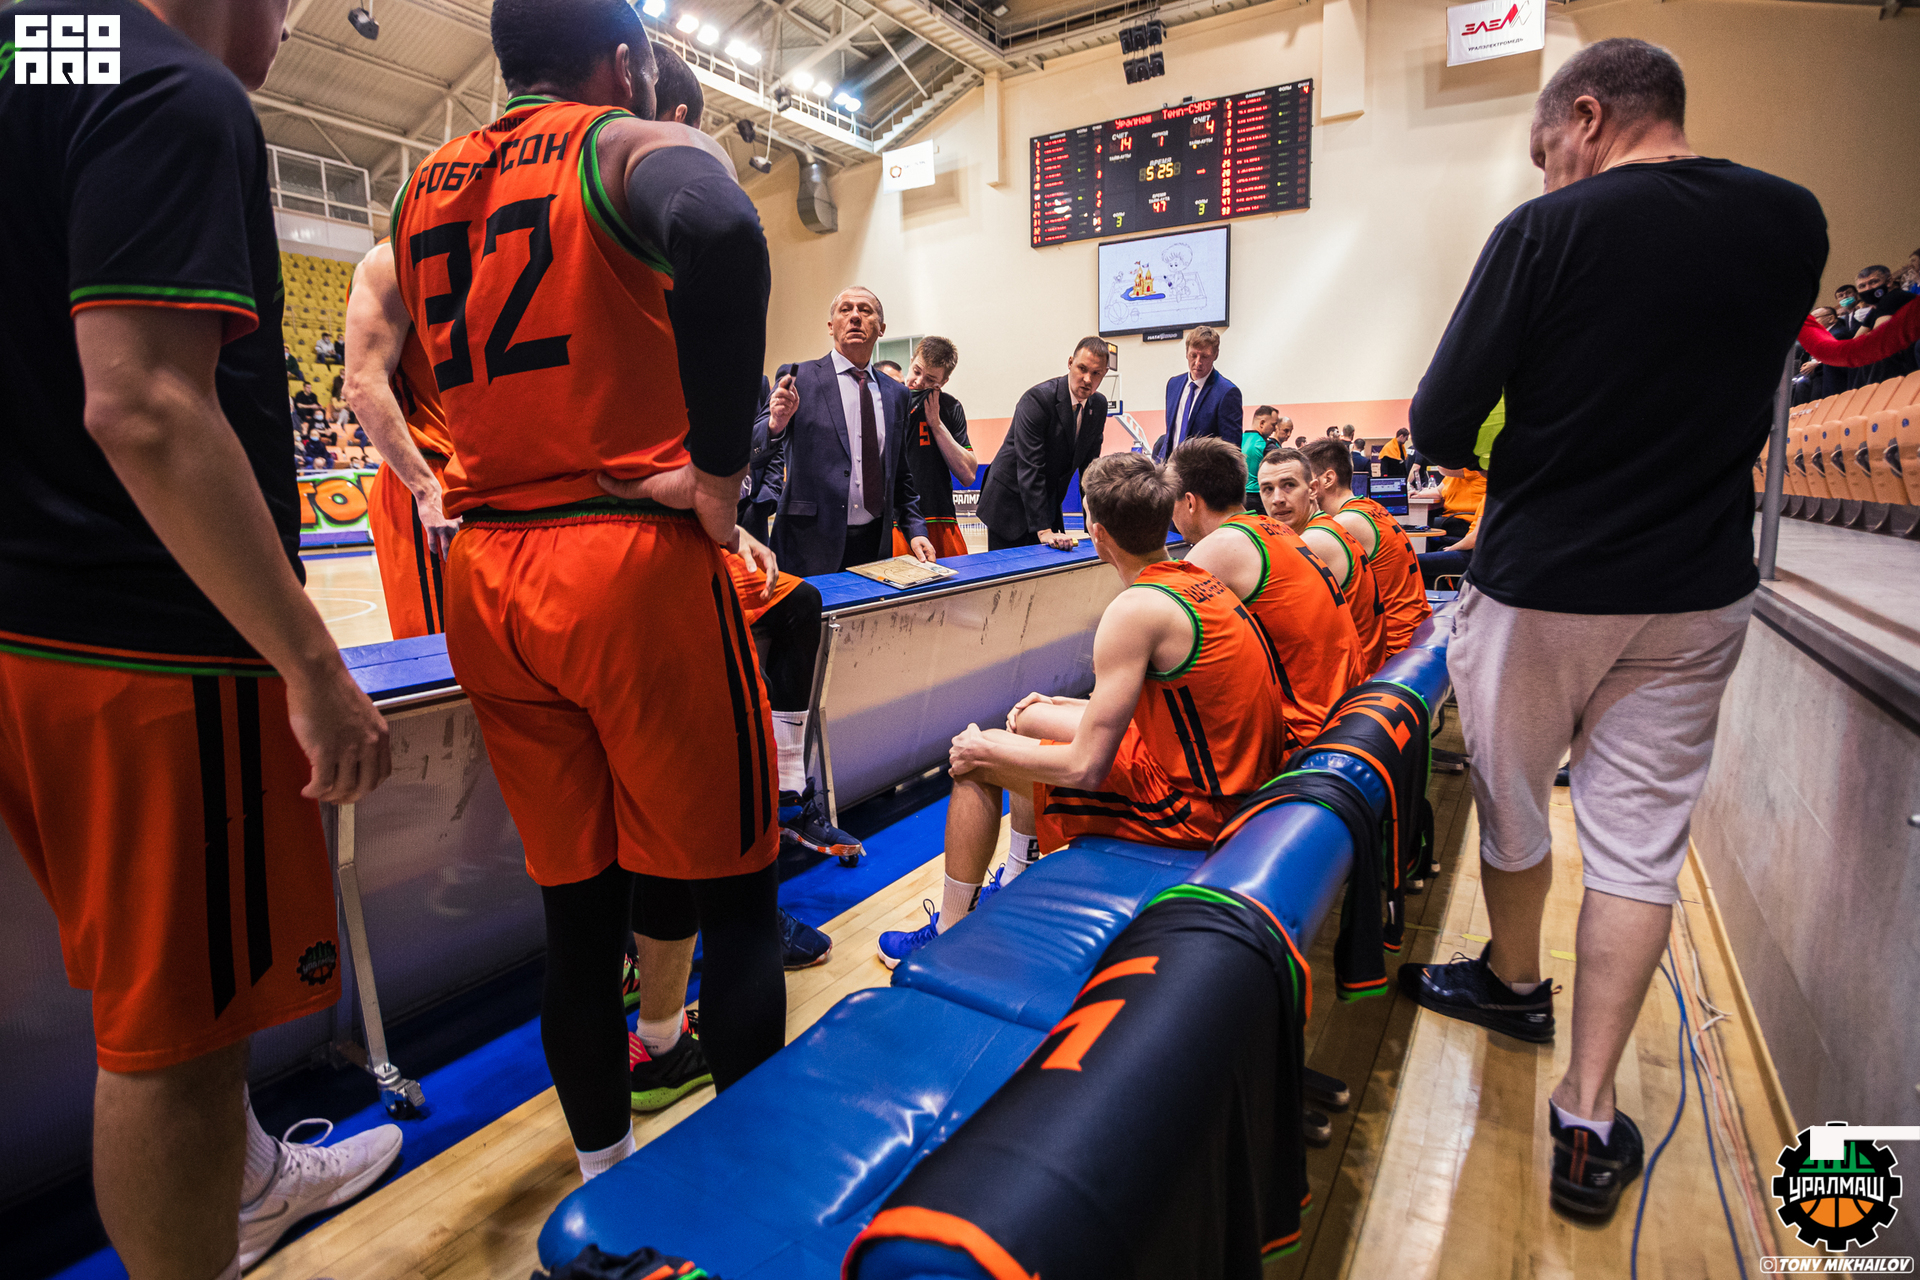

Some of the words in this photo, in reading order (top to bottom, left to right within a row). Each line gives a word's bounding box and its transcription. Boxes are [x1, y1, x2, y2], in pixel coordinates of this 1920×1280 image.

[1205, 119, 1214, 135] 4
[1120, 136, 1132, 152] 14
[1152, 200, 1166, 213] 47
[1198, 203, 1205, 215] 3
[1116, 216, 1122, 227] 3
[409, 194, 573, 393] 32
[919, 421, 931, 446] 5
